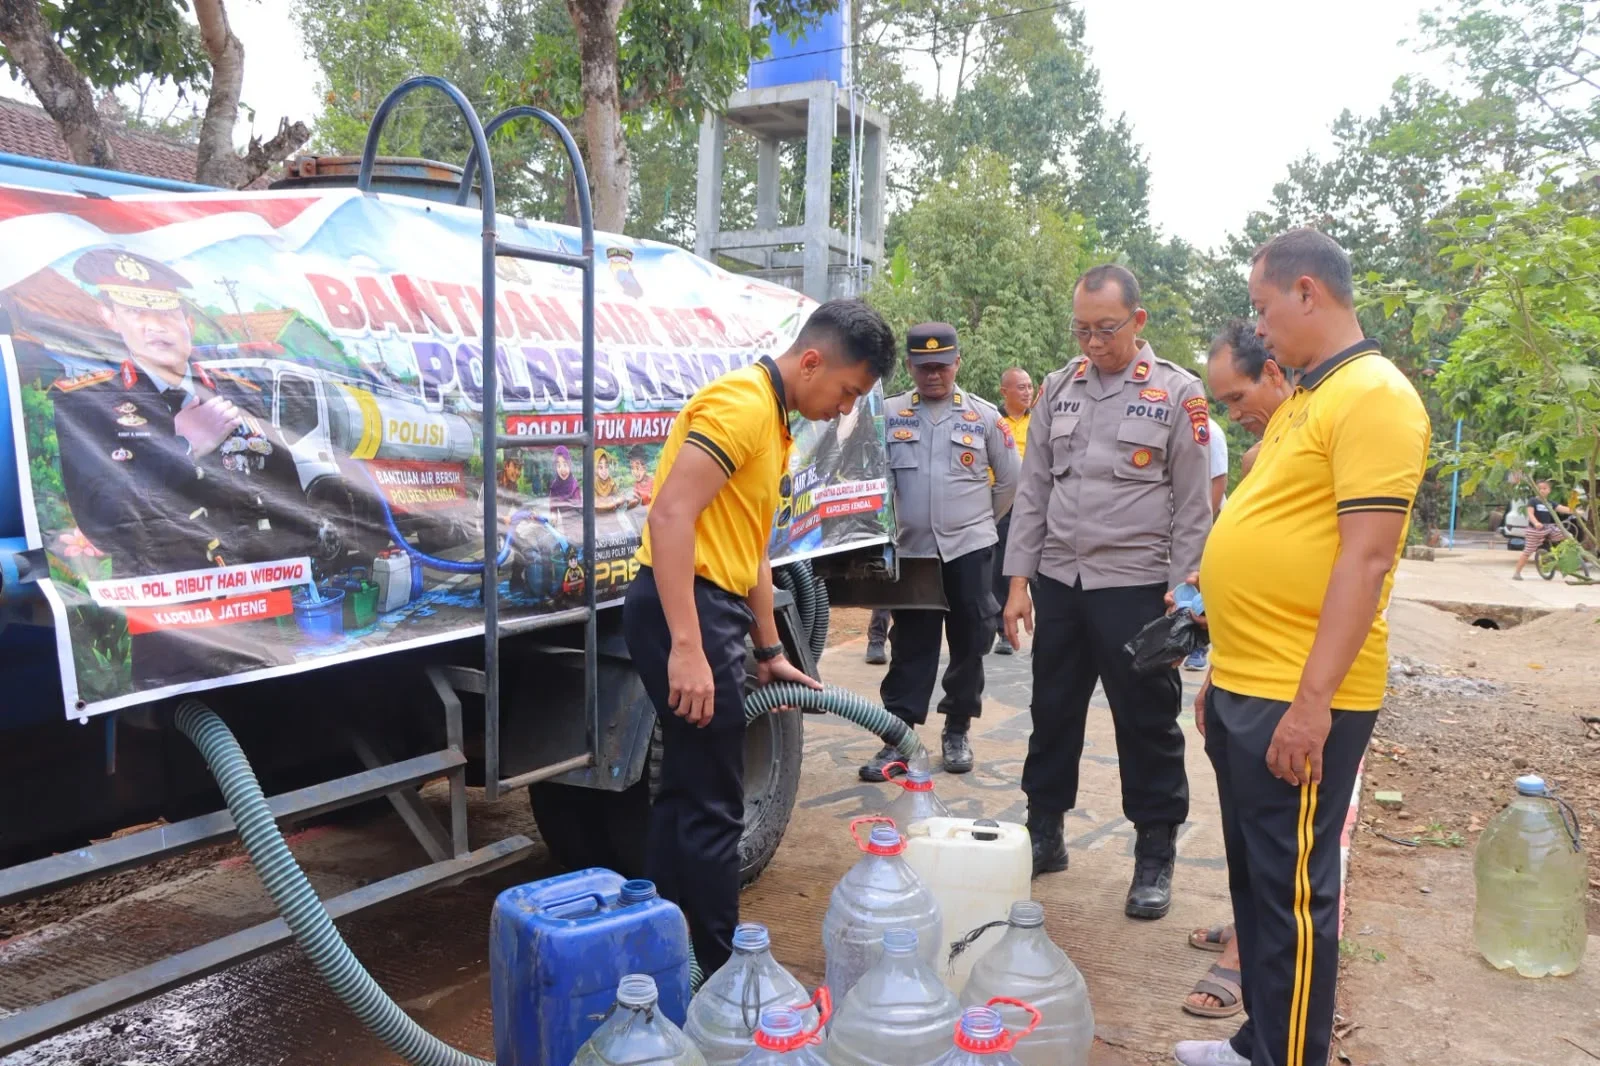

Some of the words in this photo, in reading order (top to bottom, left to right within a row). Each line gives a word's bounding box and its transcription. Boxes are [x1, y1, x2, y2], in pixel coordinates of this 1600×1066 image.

[412, 341, 620, 404] POLRES
[1126, 404, 1169, 421] POLRI
[388, 420, 445, 446] POLISI
[953, 422, 985, 434] POLRI
[375, 470, 418, 485] BANTUAN
[420, 471, 435, 485] AIR
[435, 471, 461, 484] BERSIH
[794, 473, 806, 495] AIR
[142, 580, 172, 598] POL.
[176, 576, 213, 595] RIBUT
[217, 572, 247, 589] HARI
[251, 565, 303, 585] WIBOWO
[154, 611, 213, 625] KAPOLDA
[219, 598, 267, 620] JATENG
